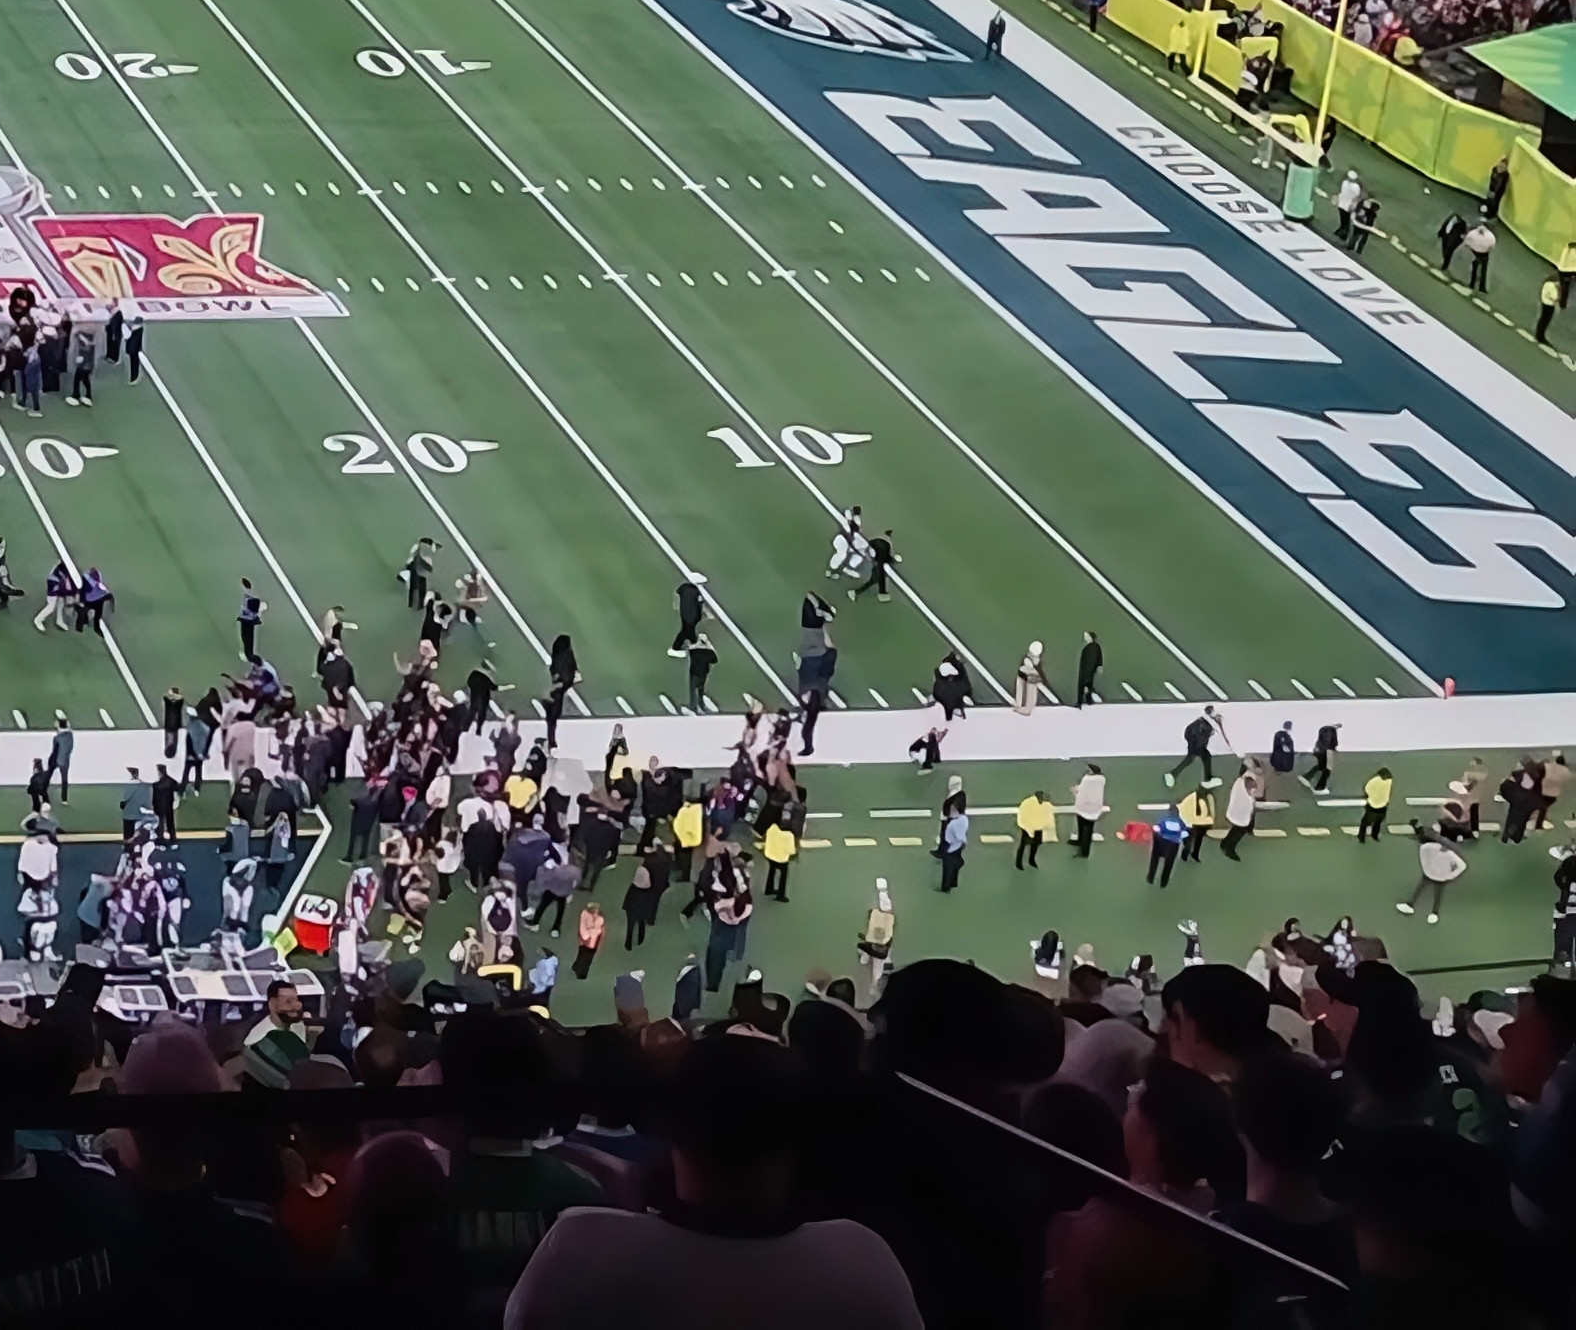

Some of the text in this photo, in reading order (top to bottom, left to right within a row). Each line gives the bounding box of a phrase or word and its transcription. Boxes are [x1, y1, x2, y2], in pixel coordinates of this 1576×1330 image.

[1115, 126, 1426, 327] CHOOSE LOVE
[824, 90, 1576, 609] EAGLES
[323, 432, 469, 474] 20
[707, 425, 844, 468] 10
